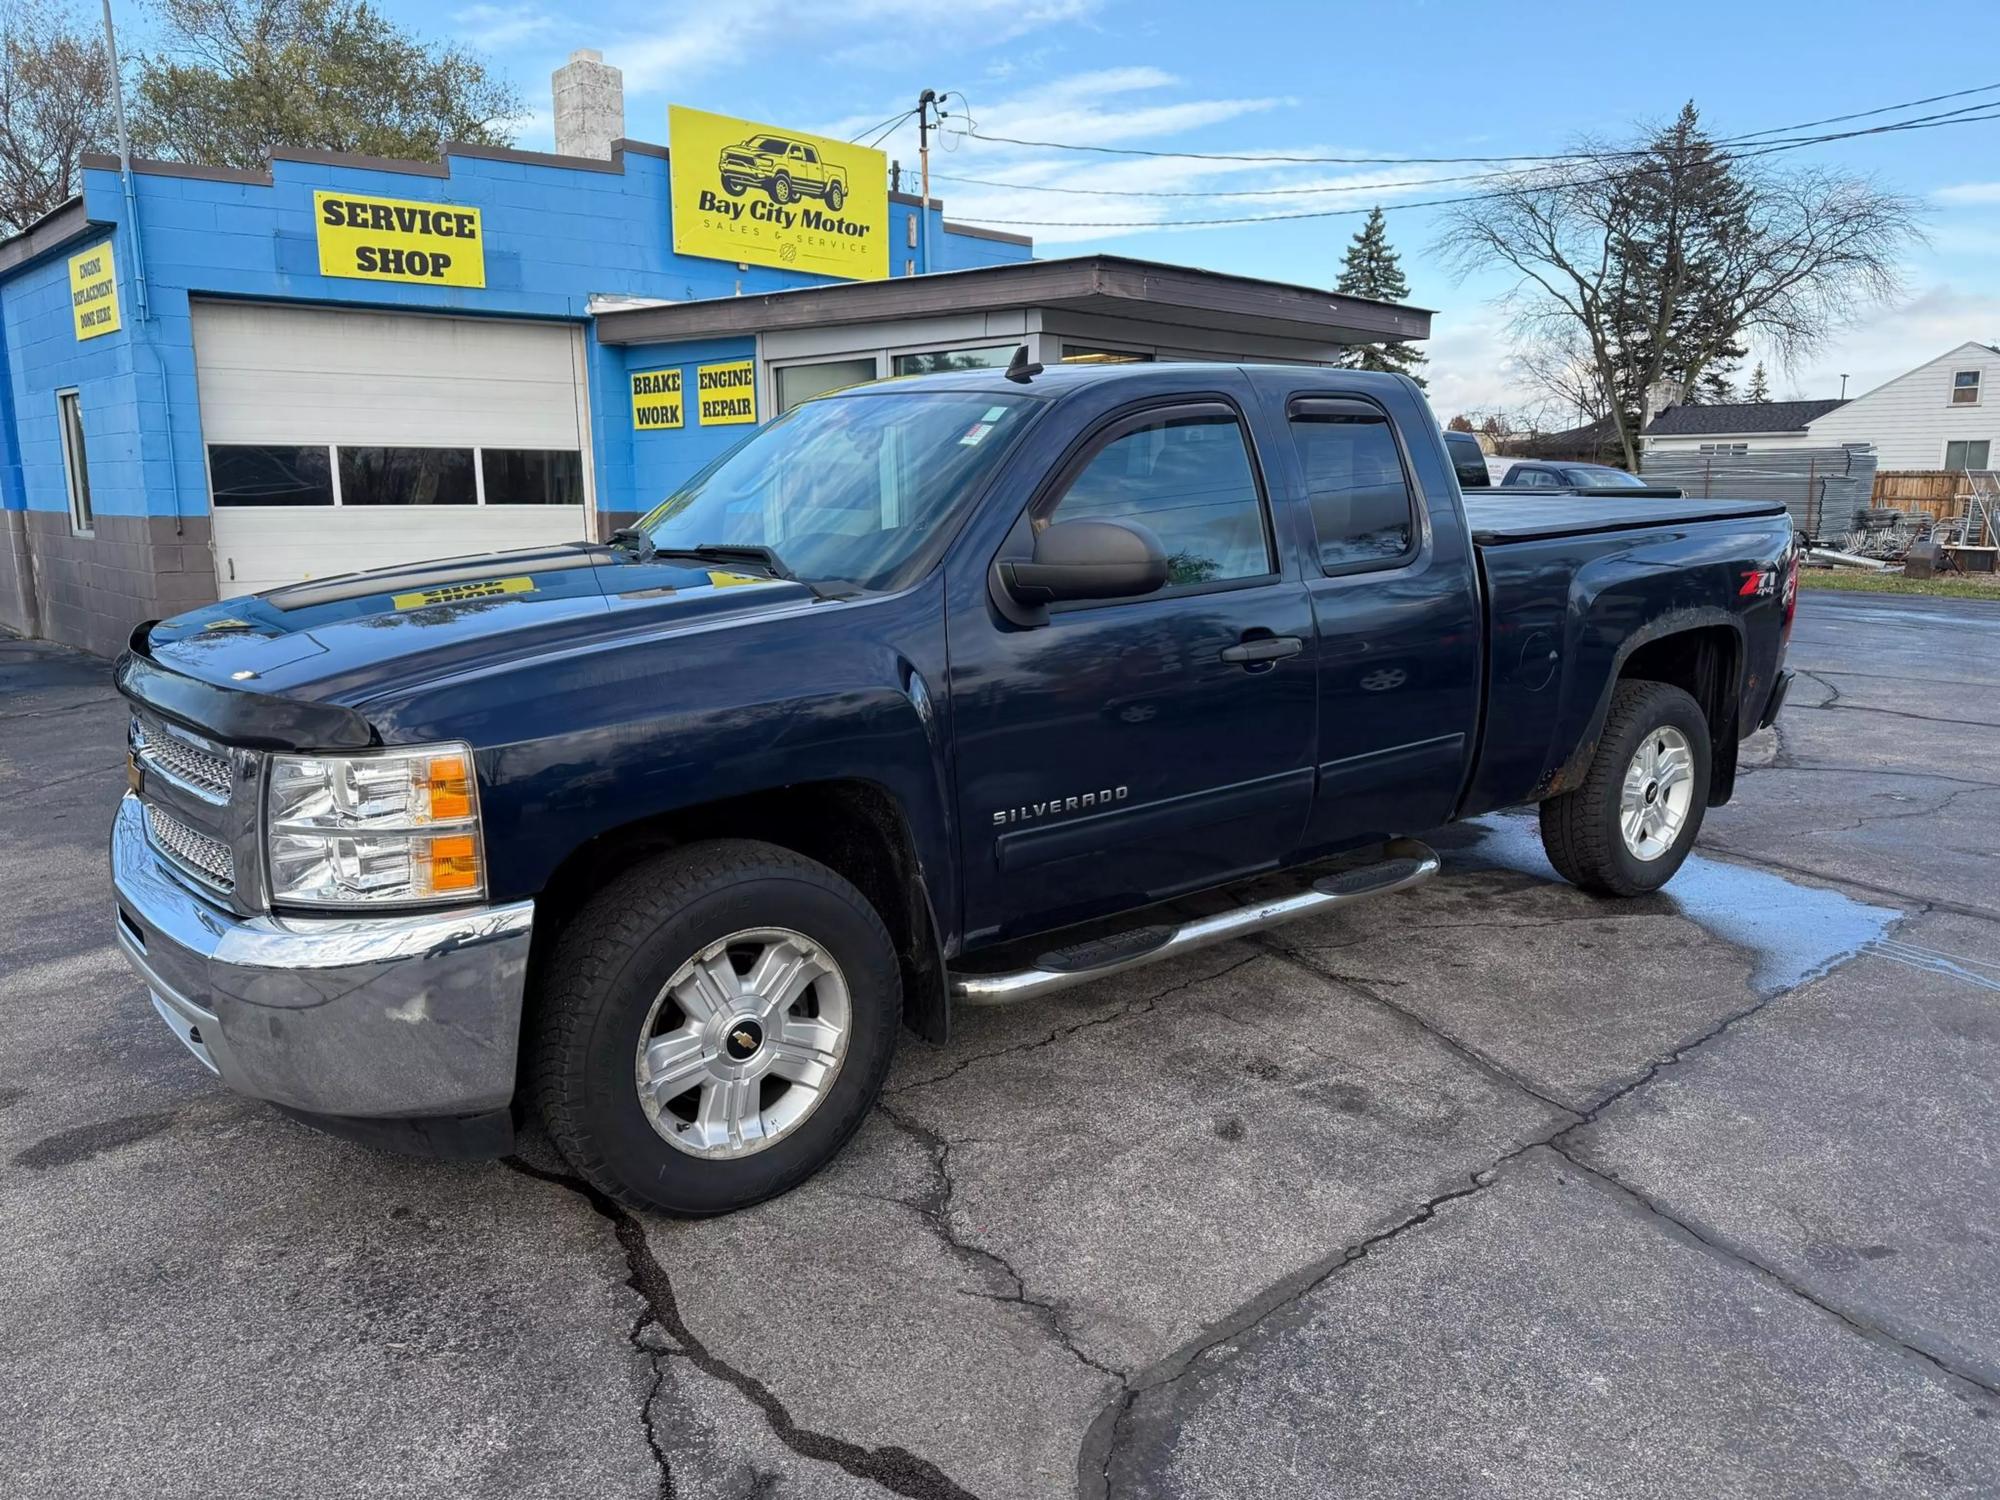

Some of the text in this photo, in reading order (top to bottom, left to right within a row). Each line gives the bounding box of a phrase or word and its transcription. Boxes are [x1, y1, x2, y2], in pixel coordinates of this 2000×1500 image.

[322, 199, 476, 239] SERVICE
[699, 190, 870, 237] Bay City Motor
[703, 219, 868, 254] SALES & SERVICE
[79, 257, 101, 280] ENGINE
[355, 246, 451, 278] SHOP
[73, 279, 113, 307] REPLACEMENT
[80, 305, 112, 329] DONE HERE
[633, 373, 680, 395] BRAKE
[699, 368, 752, 390] ENGINE
[636, 405, 680, 425] WORK
[702, 398, 752, 418] REPAIR
[1739, 570, 1776, 596] Z71
[993, 786, 1128, 826] SILVERADO
